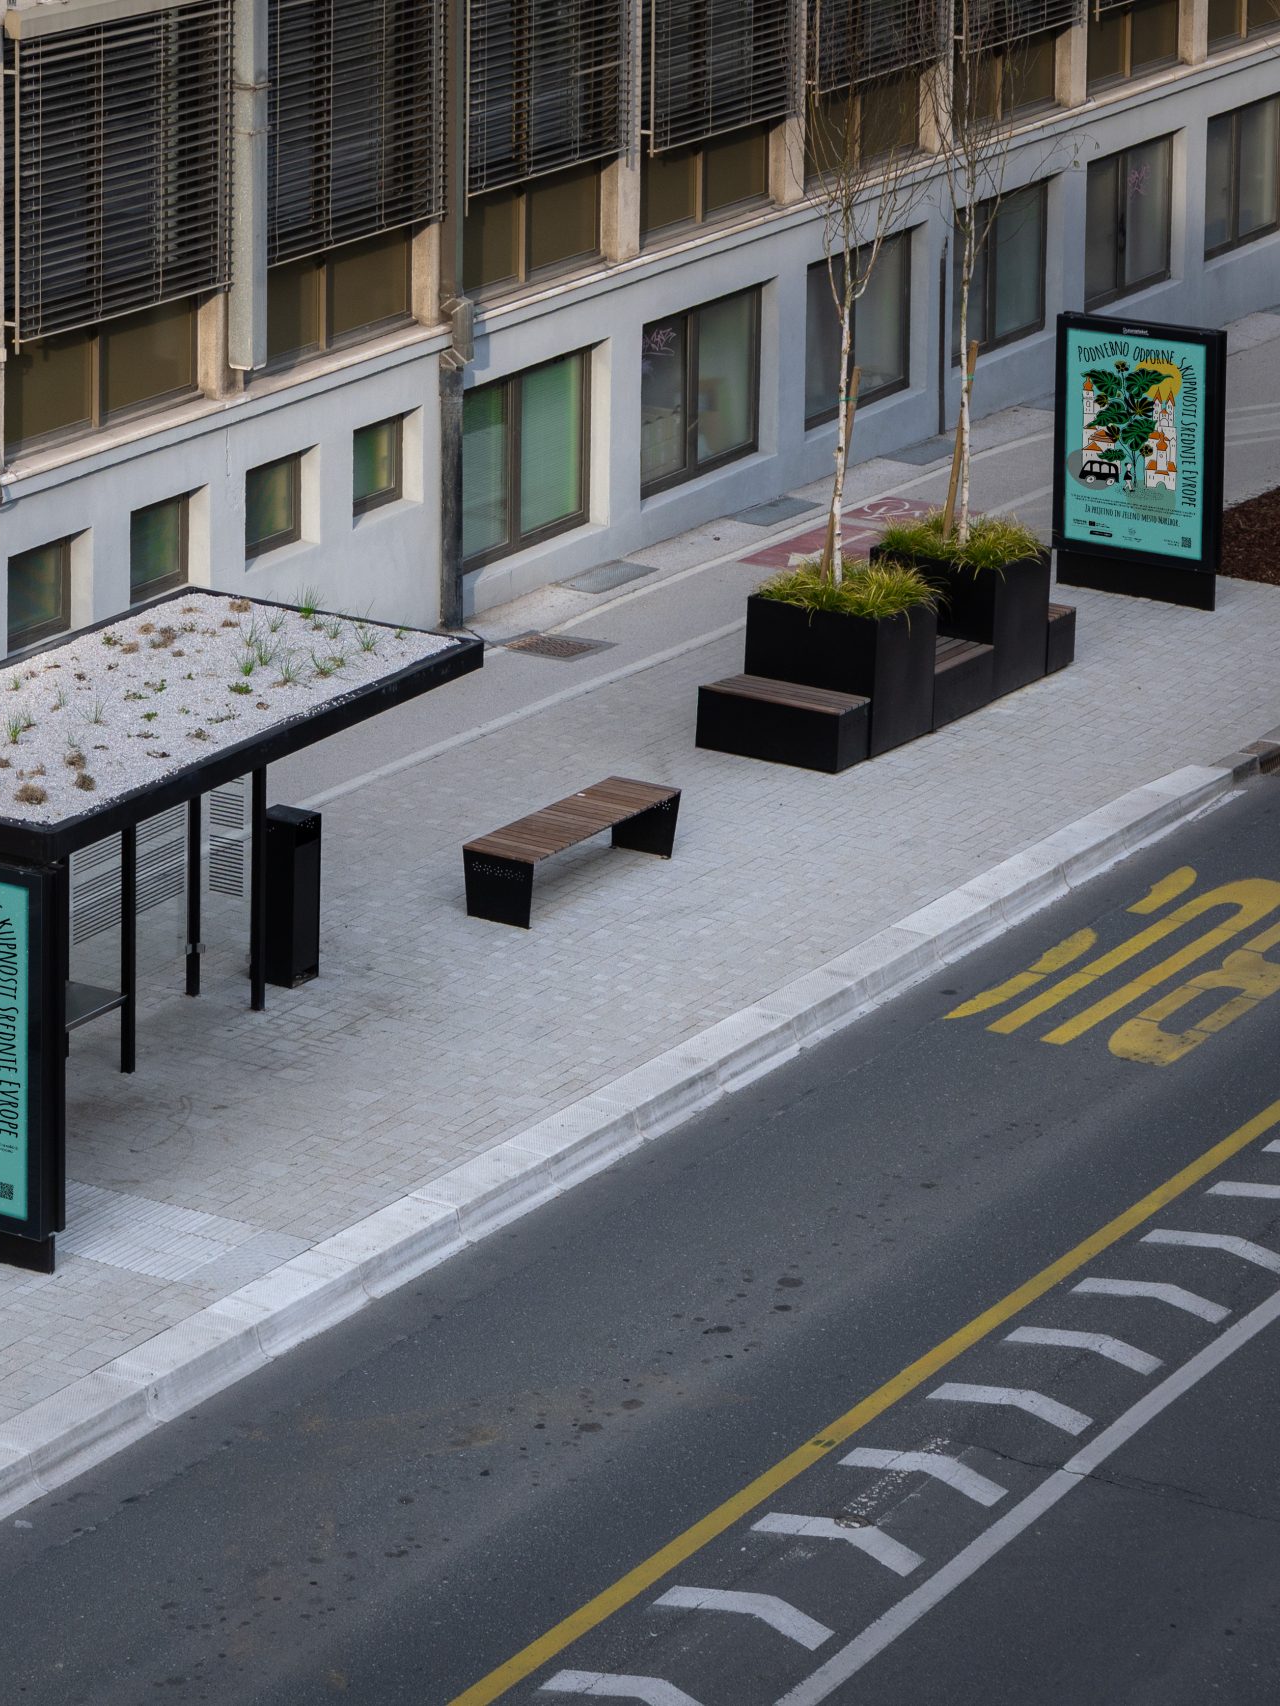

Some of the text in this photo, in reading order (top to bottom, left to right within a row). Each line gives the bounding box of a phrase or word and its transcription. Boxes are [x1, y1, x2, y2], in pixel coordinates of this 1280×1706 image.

[1078, 341, 1198, 508] PODNEBNO ODPORNE SKUPNOSTI SREDNJE EVROPE
[0, 1079, 20, 1138] EVROPE
